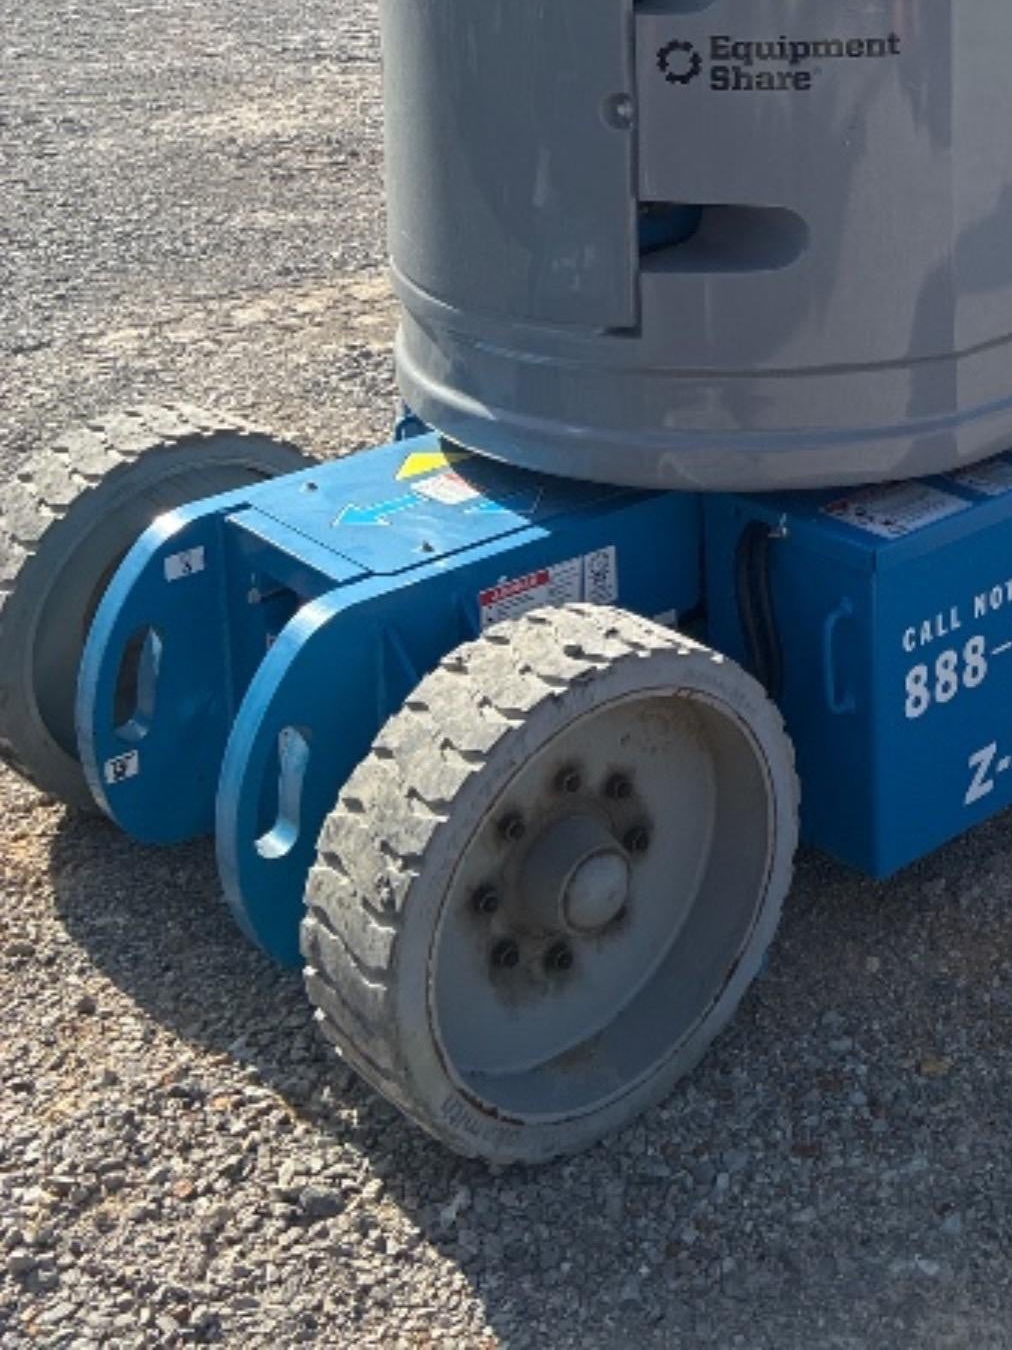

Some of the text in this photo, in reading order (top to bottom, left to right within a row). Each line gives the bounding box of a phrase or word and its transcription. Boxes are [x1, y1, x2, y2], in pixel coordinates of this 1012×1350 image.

[708, 32, 901, 67] Equipment
[709, 65, 811, 91] Share
[902, 606, 961, 652] CALL
